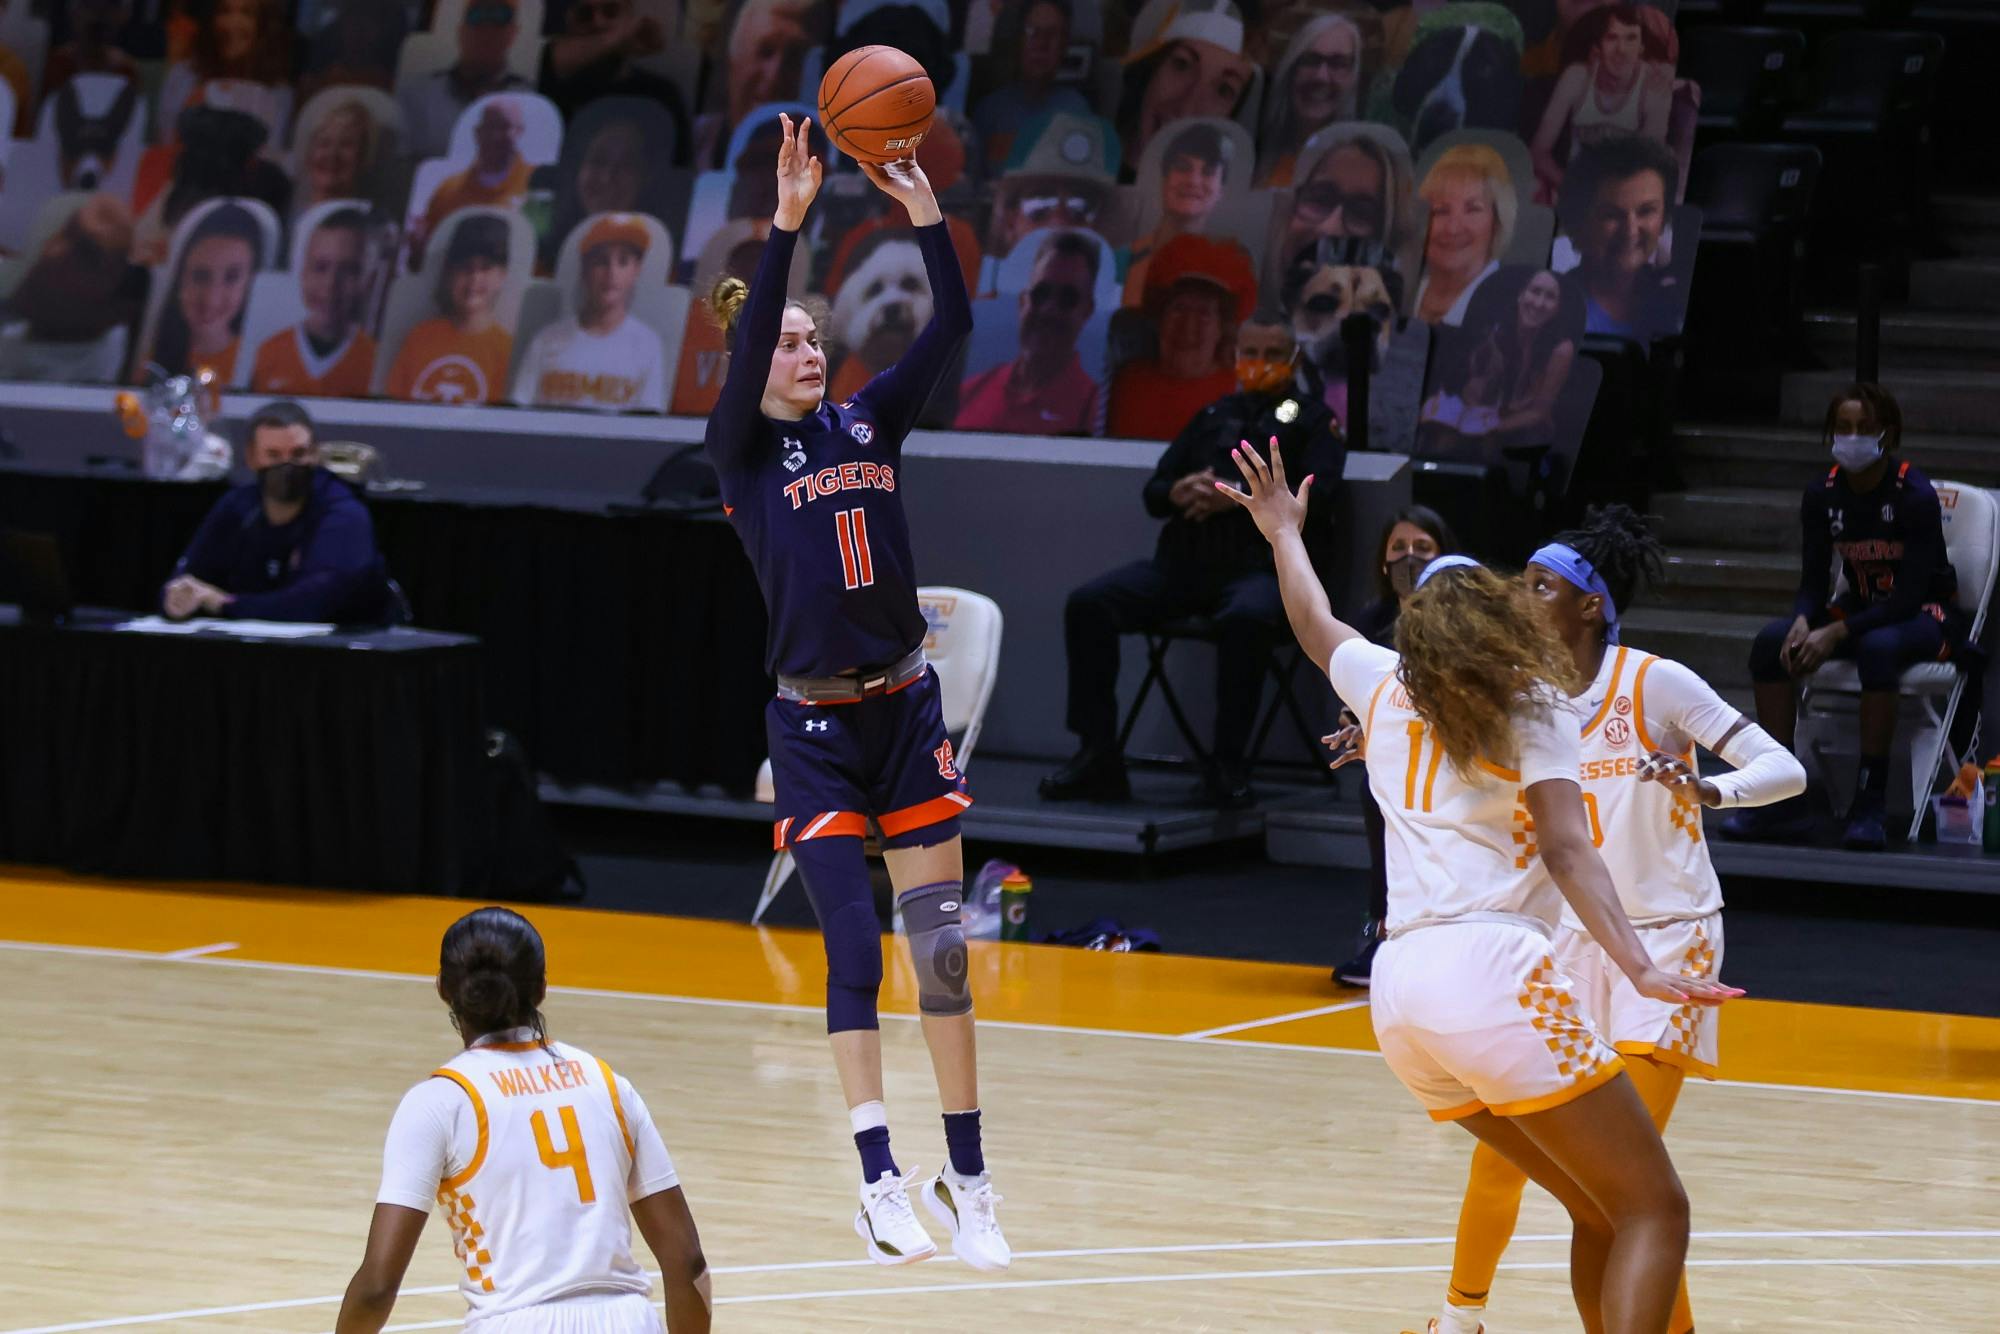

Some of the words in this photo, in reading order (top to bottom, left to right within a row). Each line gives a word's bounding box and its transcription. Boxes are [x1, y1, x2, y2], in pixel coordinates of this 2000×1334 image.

[783, 461, 896, 510] TIGERS
[835, 507, 875, 590] 11
[1405, 721, 1445, 813] 11
[489, 1060, 589, 1098] WALKER
[530, 1105, 597, 1204] 4
